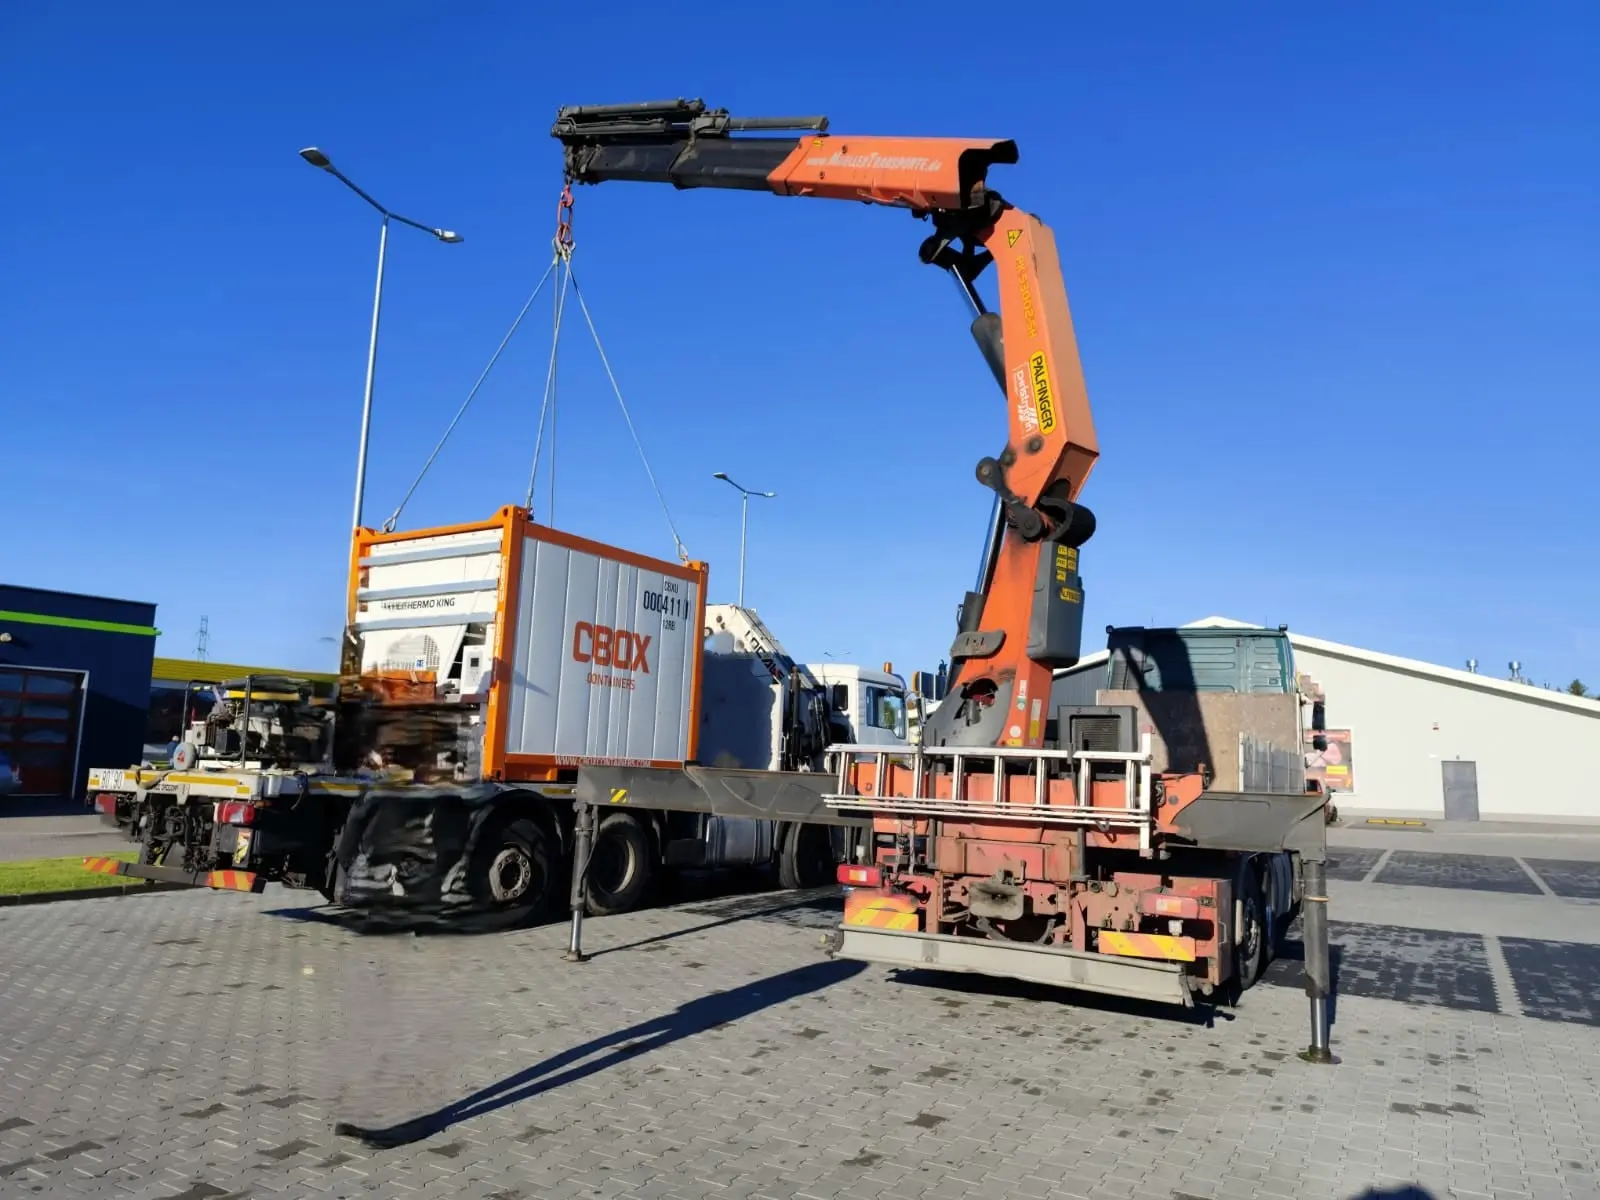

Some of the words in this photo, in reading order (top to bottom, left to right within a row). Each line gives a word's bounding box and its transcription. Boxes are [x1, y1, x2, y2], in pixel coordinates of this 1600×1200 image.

[1032, 355, 1053, 430] PALFINGER
[436, 597, 456, 608] KING
[573, 620, 652, 674] CBOX
[586, 672, 636, 690] CONTAINERS
